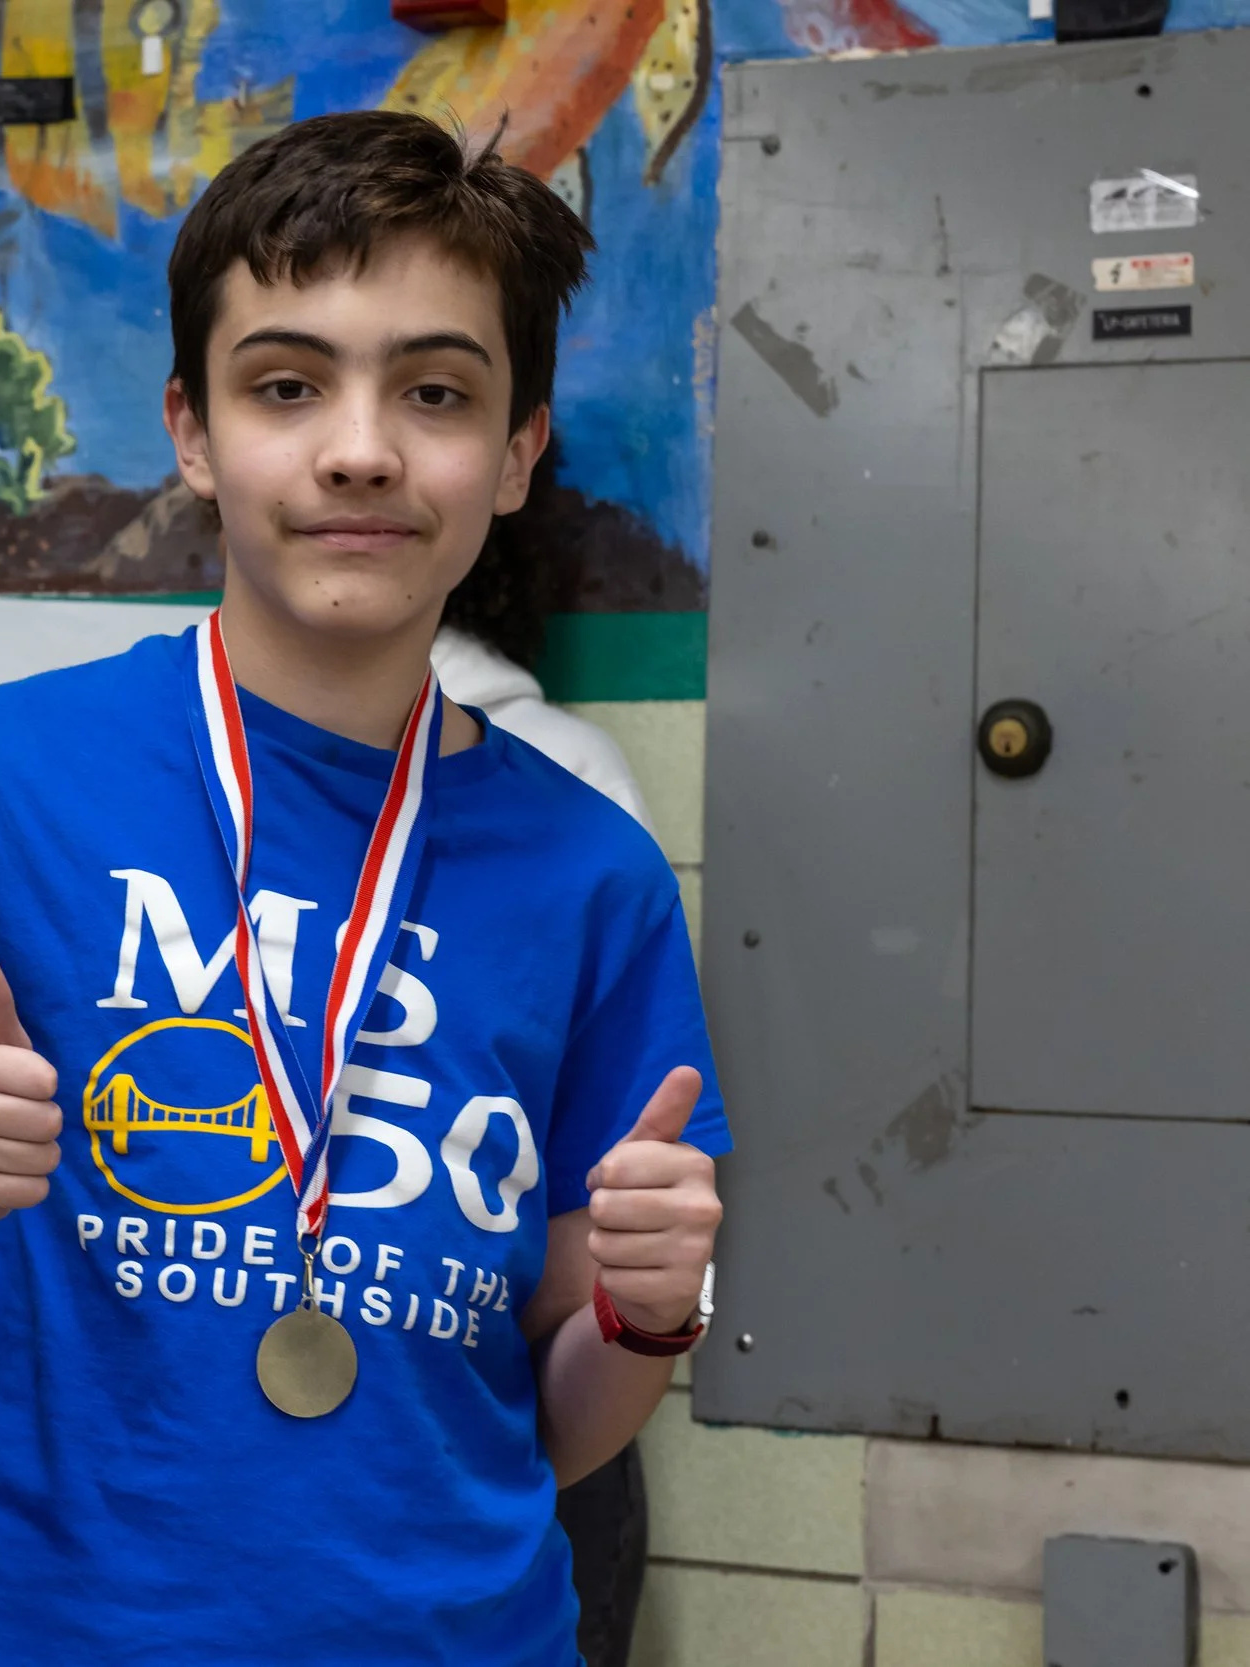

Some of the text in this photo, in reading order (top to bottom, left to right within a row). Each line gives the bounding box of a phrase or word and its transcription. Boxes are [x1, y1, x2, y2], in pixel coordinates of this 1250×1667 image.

[96, 868, 439, 1047] MS
[328, 1063, 539, 1233] 50
[77, 1214, 510, 1312] PRIDE OF THE
[115, 1260, 479, 1348] SOUTHSIDE
